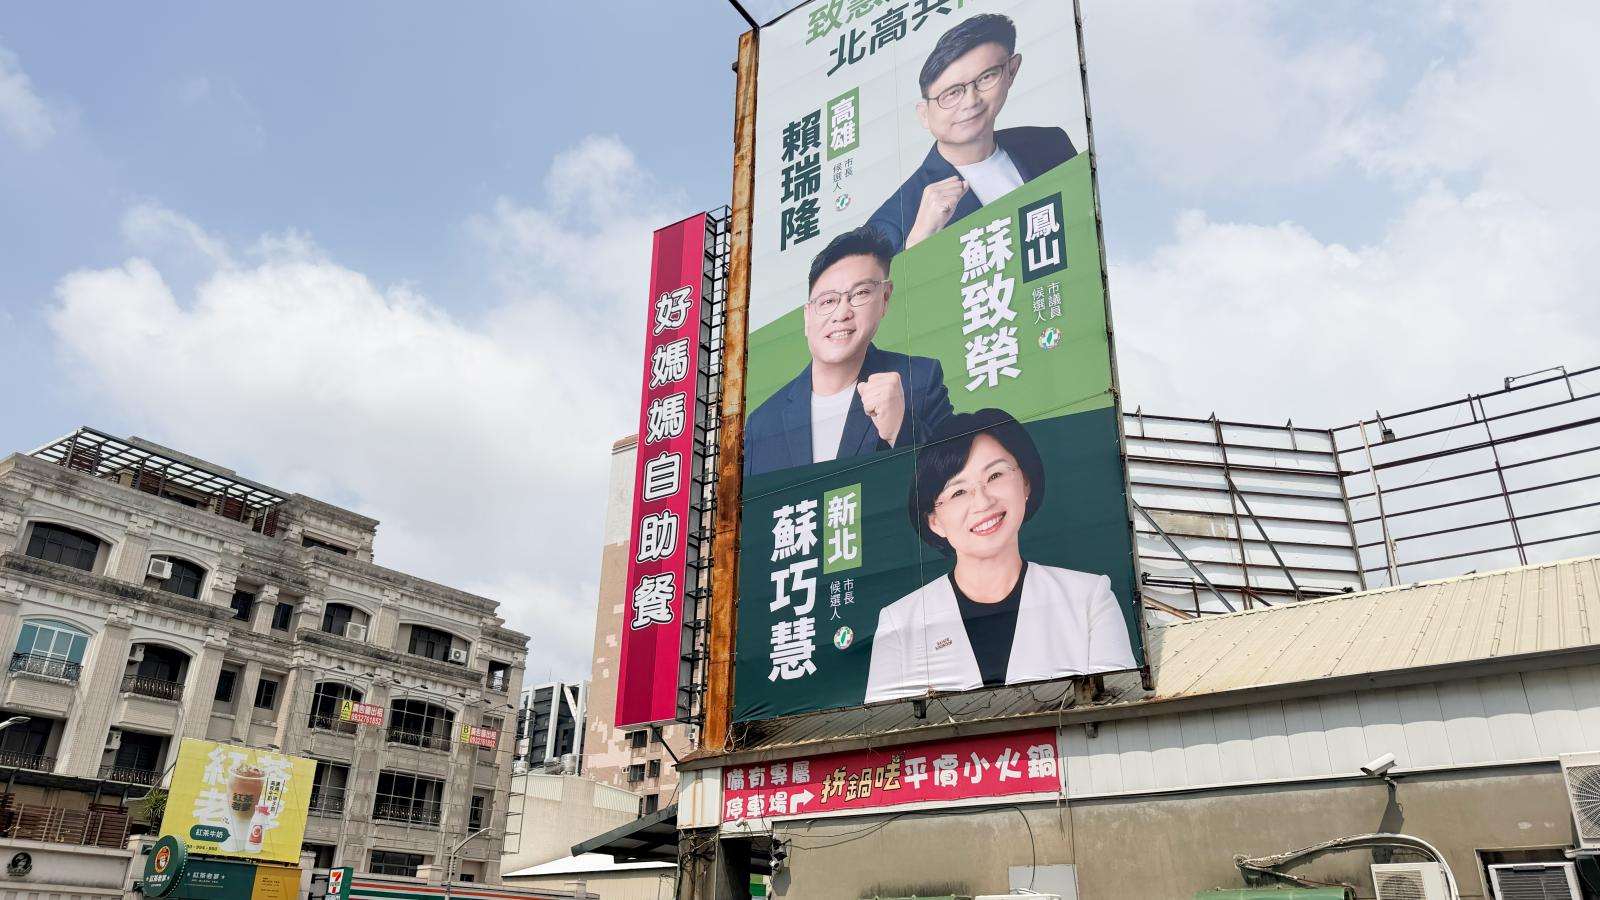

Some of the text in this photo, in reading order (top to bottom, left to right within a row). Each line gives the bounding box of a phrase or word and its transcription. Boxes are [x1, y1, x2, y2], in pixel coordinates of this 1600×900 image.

[830, 98, 856, 151] 高雄
[781, 109, 821, 252] 賴瑞隆
[833, 164, 842, 192] 候選人
[844, 158, 854, 178] 市長
[1025, 203, 1060, 272] 鳳山
[960, 217, 1022, 392] 蘇致榮
[1032, 287, 1046, 325] 候選人
[1048, 282, 1062, 320] 市議員
[631, 286, 693, 630] 好媽媽自助餐
[828, 492, 858, 564] 新北
[768, 499, 818, 682] 蘇巧慧
[830, 581, 841, 621] 候選人
[843, 579, 854, 605] 市長
[343, 701, 350, 711] A
[727, 760, 810, 790] 備有專屬
[904, 744, 1057, 789] 平價小火鍋
[726, 791, 788, 819] 停車場
